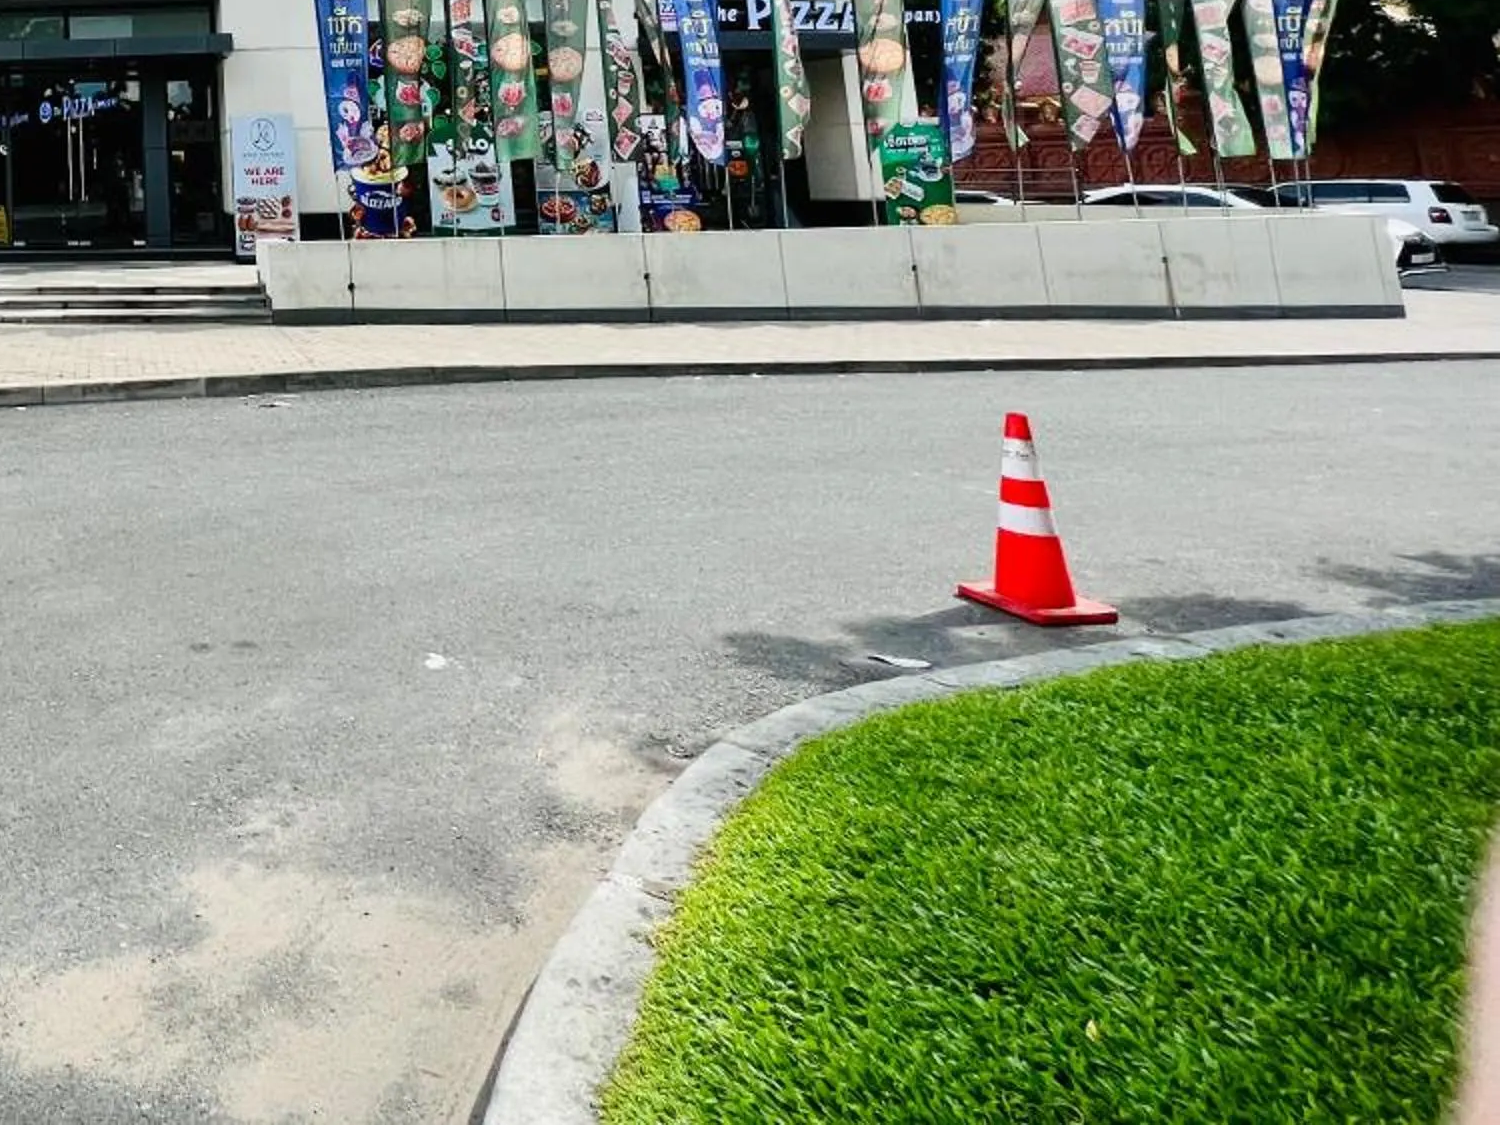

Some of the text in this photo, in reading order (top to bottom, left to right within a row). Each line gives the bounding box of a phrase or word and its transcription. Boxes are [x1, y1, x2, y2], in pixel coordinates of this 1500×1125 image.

[717, 5, 737, 22] he
[244, 166, 285, 176] WE ARE
[251, 177, 280, 186] HERE
